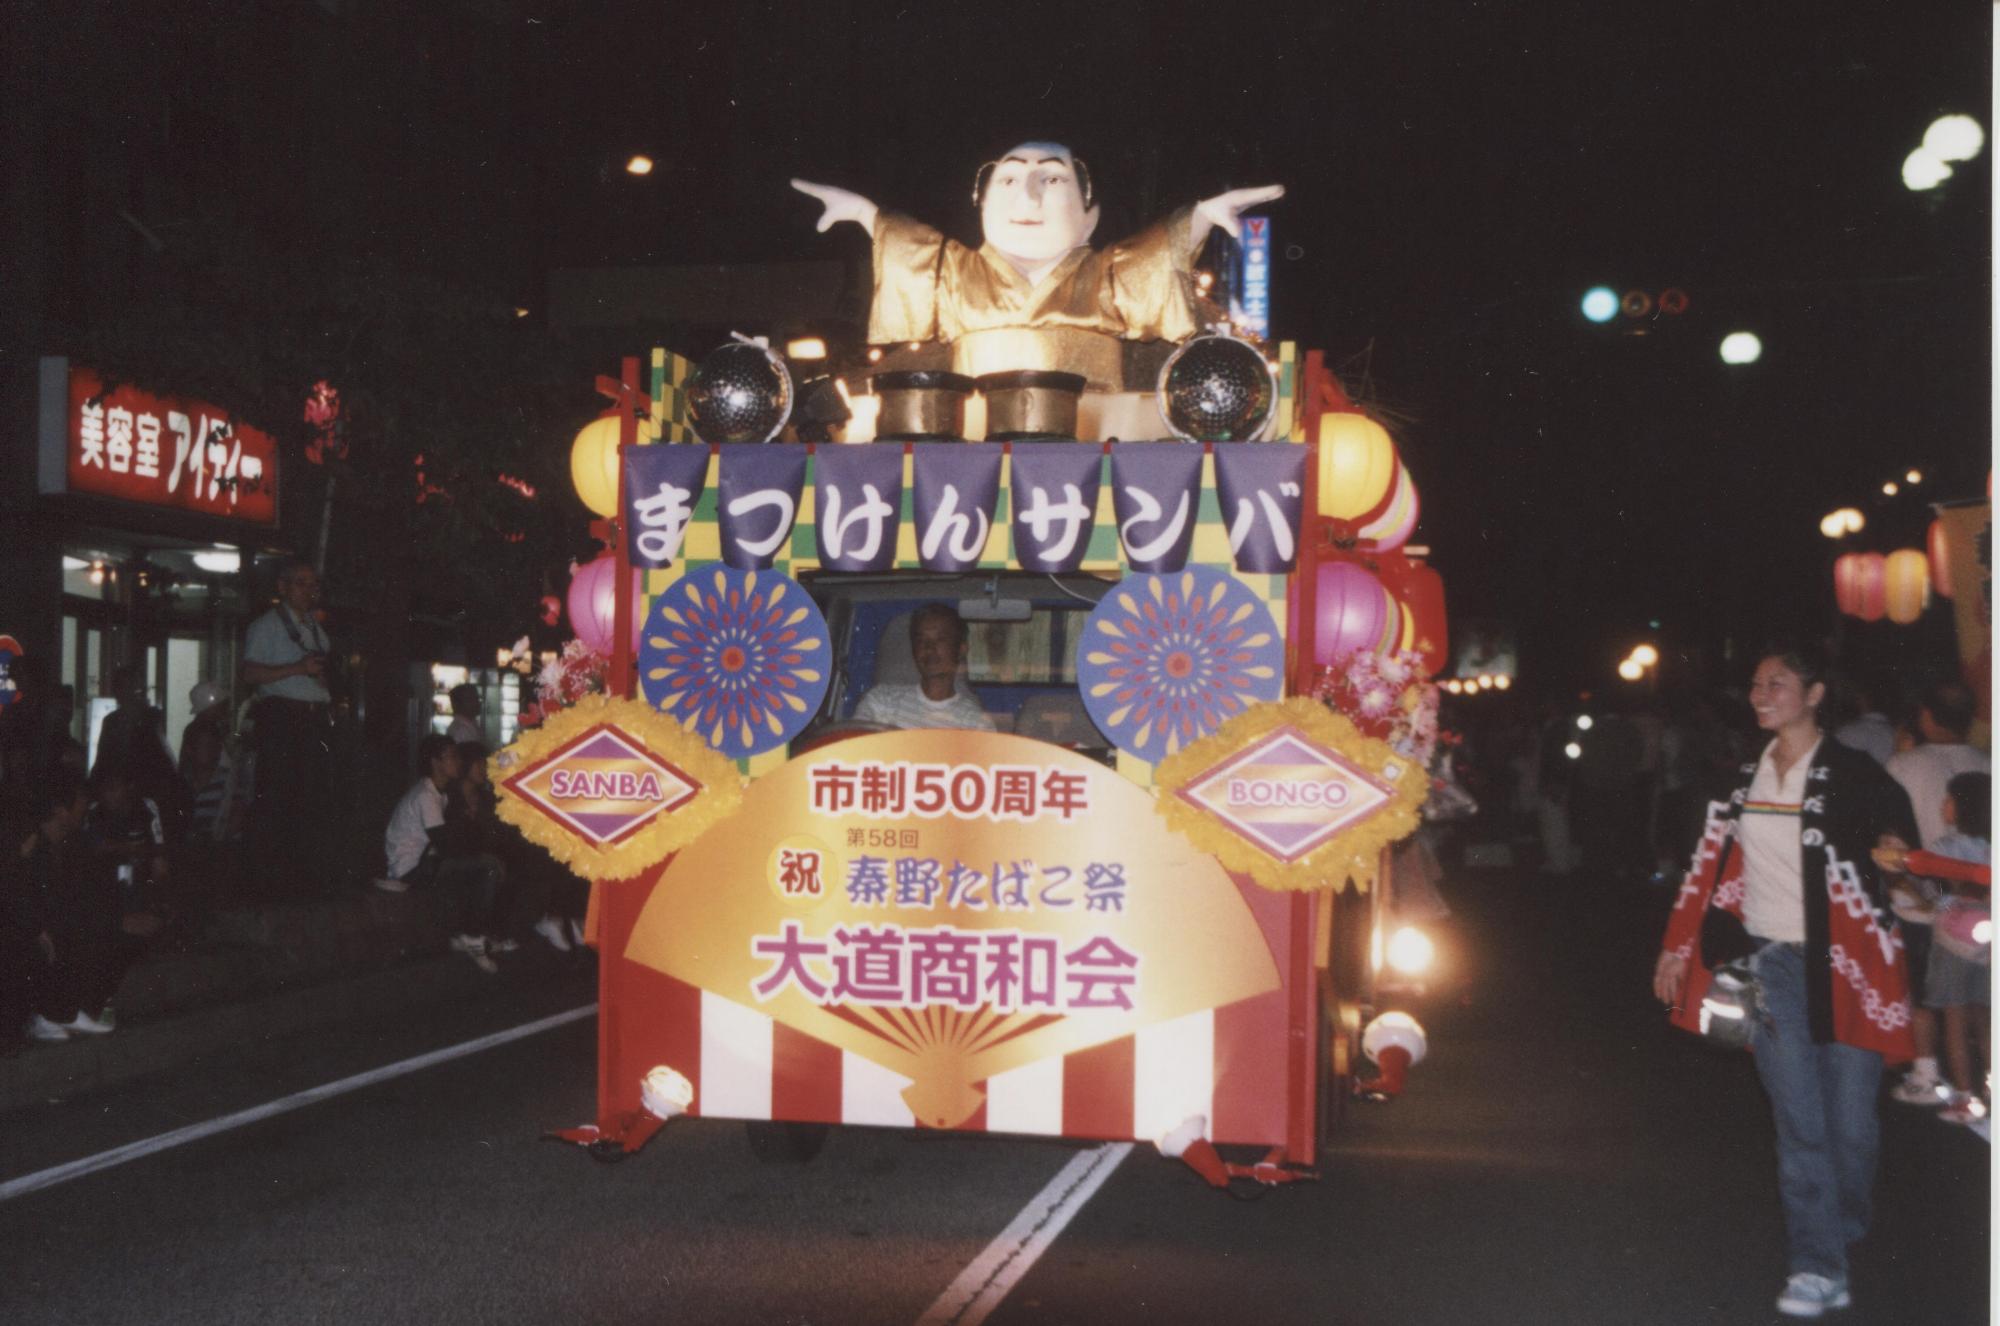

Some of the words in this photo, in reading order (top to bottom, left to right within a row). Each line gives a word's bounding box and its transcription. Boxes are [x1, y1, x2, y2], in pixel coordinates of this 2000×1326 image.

[633, 481, 1301, 564] まつけんサンバ
[551, 770, 661, 799] SANBA
[811, 764, 1089, 819] 市制50周年
[1231, 781, 1348, 805] BONGO
[846, 827, 920, 850] 第58回
[779, 849, 822, 895] 祝
[845, 854, 1128, 913] 秦野たばこ祭
[755, 925, 1139, 1012] 大道商和会
